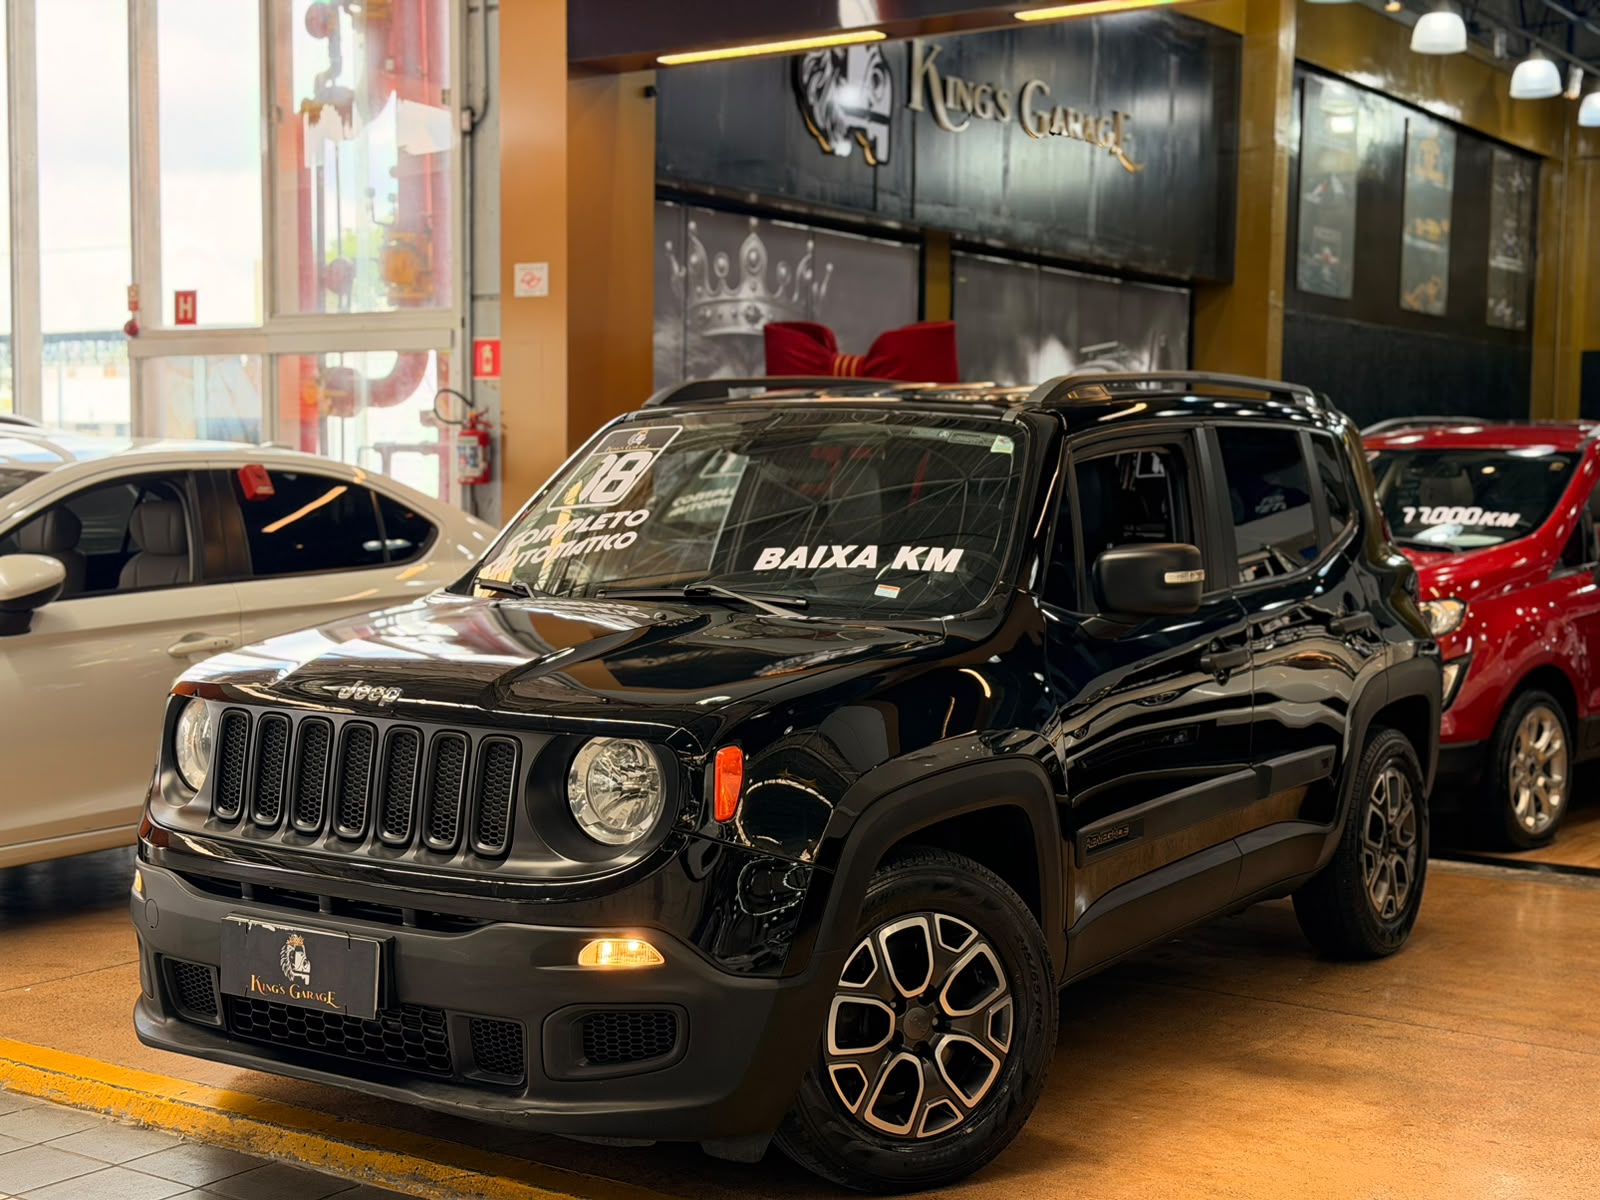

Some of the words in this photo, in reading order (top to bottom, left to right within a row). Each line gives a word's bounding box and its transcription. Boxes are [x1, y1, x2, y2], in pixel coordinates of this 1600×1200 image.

[1019, 79, 1145, 173] GARAGE
[178, 295, 193, 320] H
[579, 451, 654, 503] 18
[505, 509, 650, 552] COMPLETO
[490, 531, 638, 576] AUTOMATICO
[753, 545, 878, 571] BAIXA
[891, 546, 965, 573] KM
[250, 974, 286, 996] KING'S
[289, 983, 341, 1009] GARAGE
